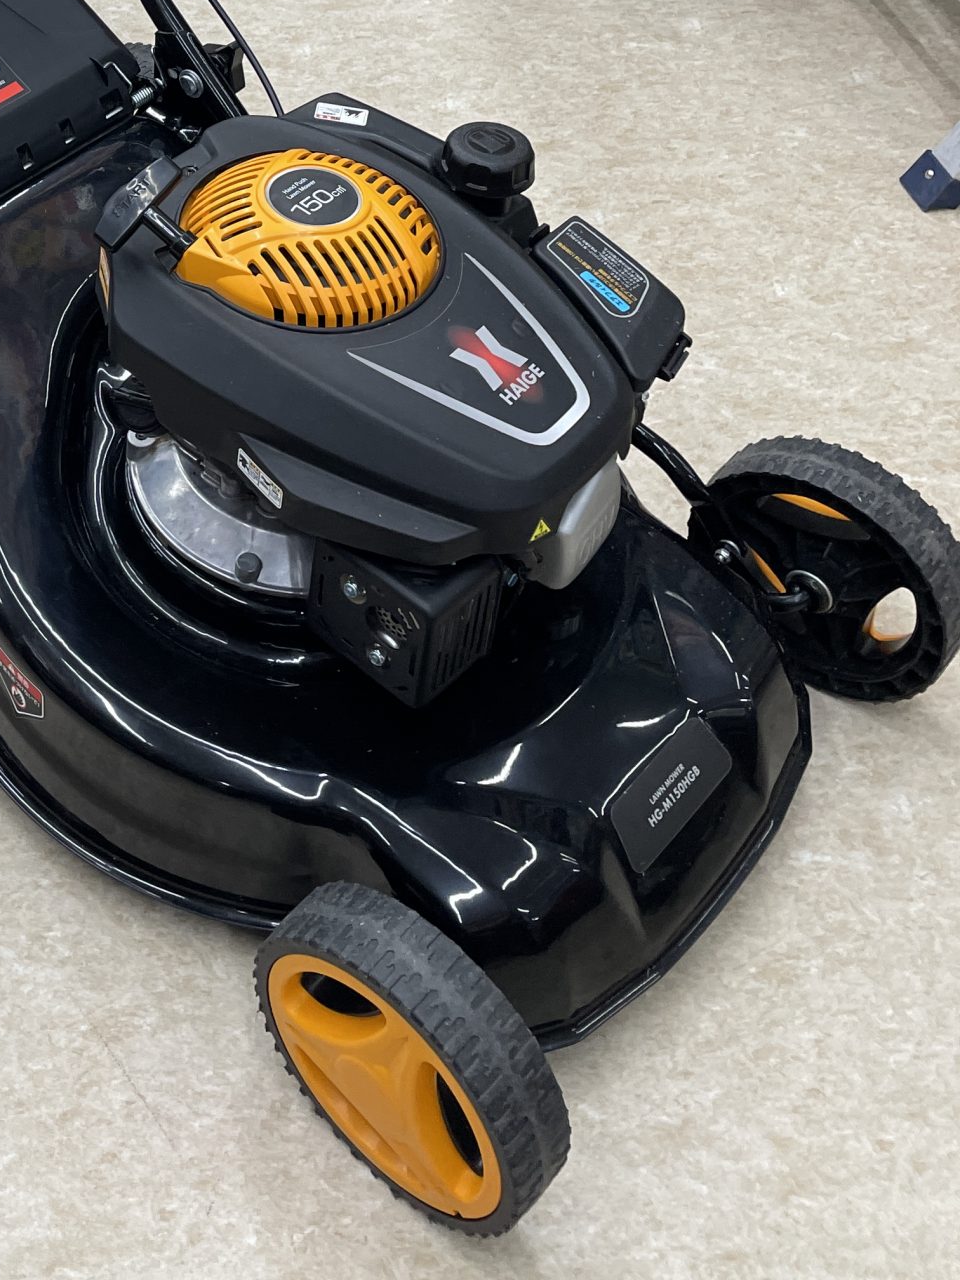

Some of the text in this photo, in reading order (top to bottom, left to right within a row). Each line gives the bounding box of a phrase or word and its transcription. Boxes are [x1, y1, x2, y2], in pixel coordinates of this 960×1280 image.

[282, 176, 308, 195] Hand Push
[286, 179, 316, 200] Lawn Mower
[498, 362, 546, 406] HAIGE
[647, 764, 701, 828] HG-M150HGB
[648, 762, 685, 805] LAWN MOWER
